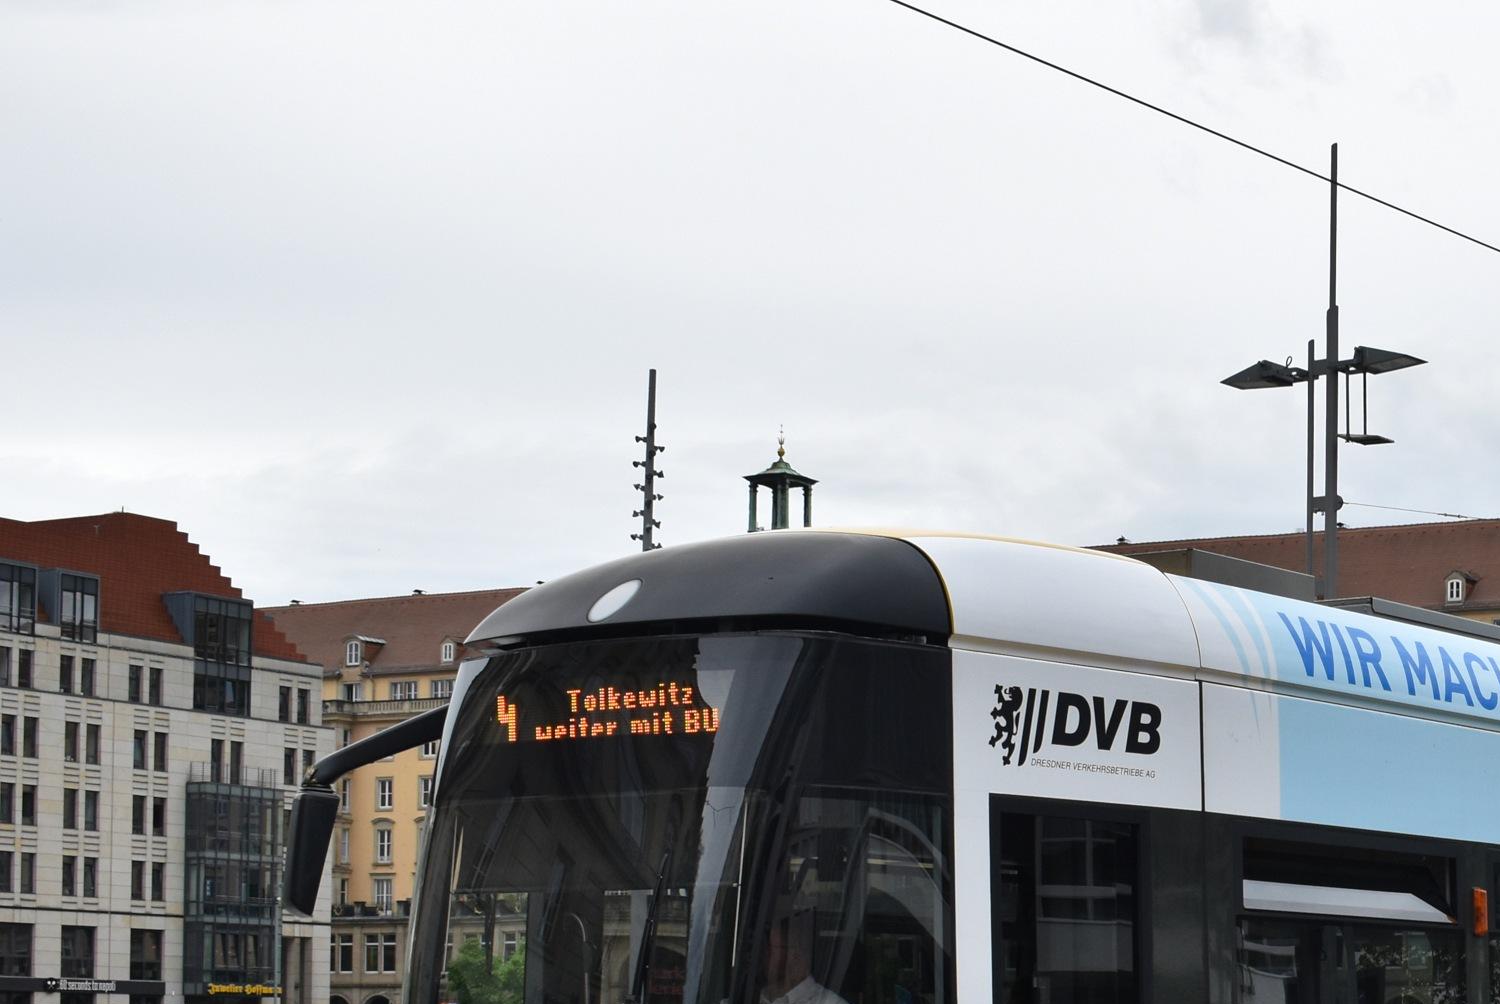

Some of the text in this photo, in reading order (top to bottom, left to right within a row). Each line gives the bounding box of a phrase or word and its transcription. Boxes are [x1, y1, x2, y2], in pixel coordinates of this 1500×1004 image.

[1277, 611, 1392, 692] WIR
[566, 682, 693, 713] Tolkewitz
[497, 695, 517, 742] 4
[535, 717, 617, 740] weiter
[630, 711, 673, 735] mit
[1051, 691, 1162, 755] DVB
[1031, 758, 1156, 779] DRESDNER VERKEHRSBETRIEBE AG
[68, 980, 92, 991] seconds
